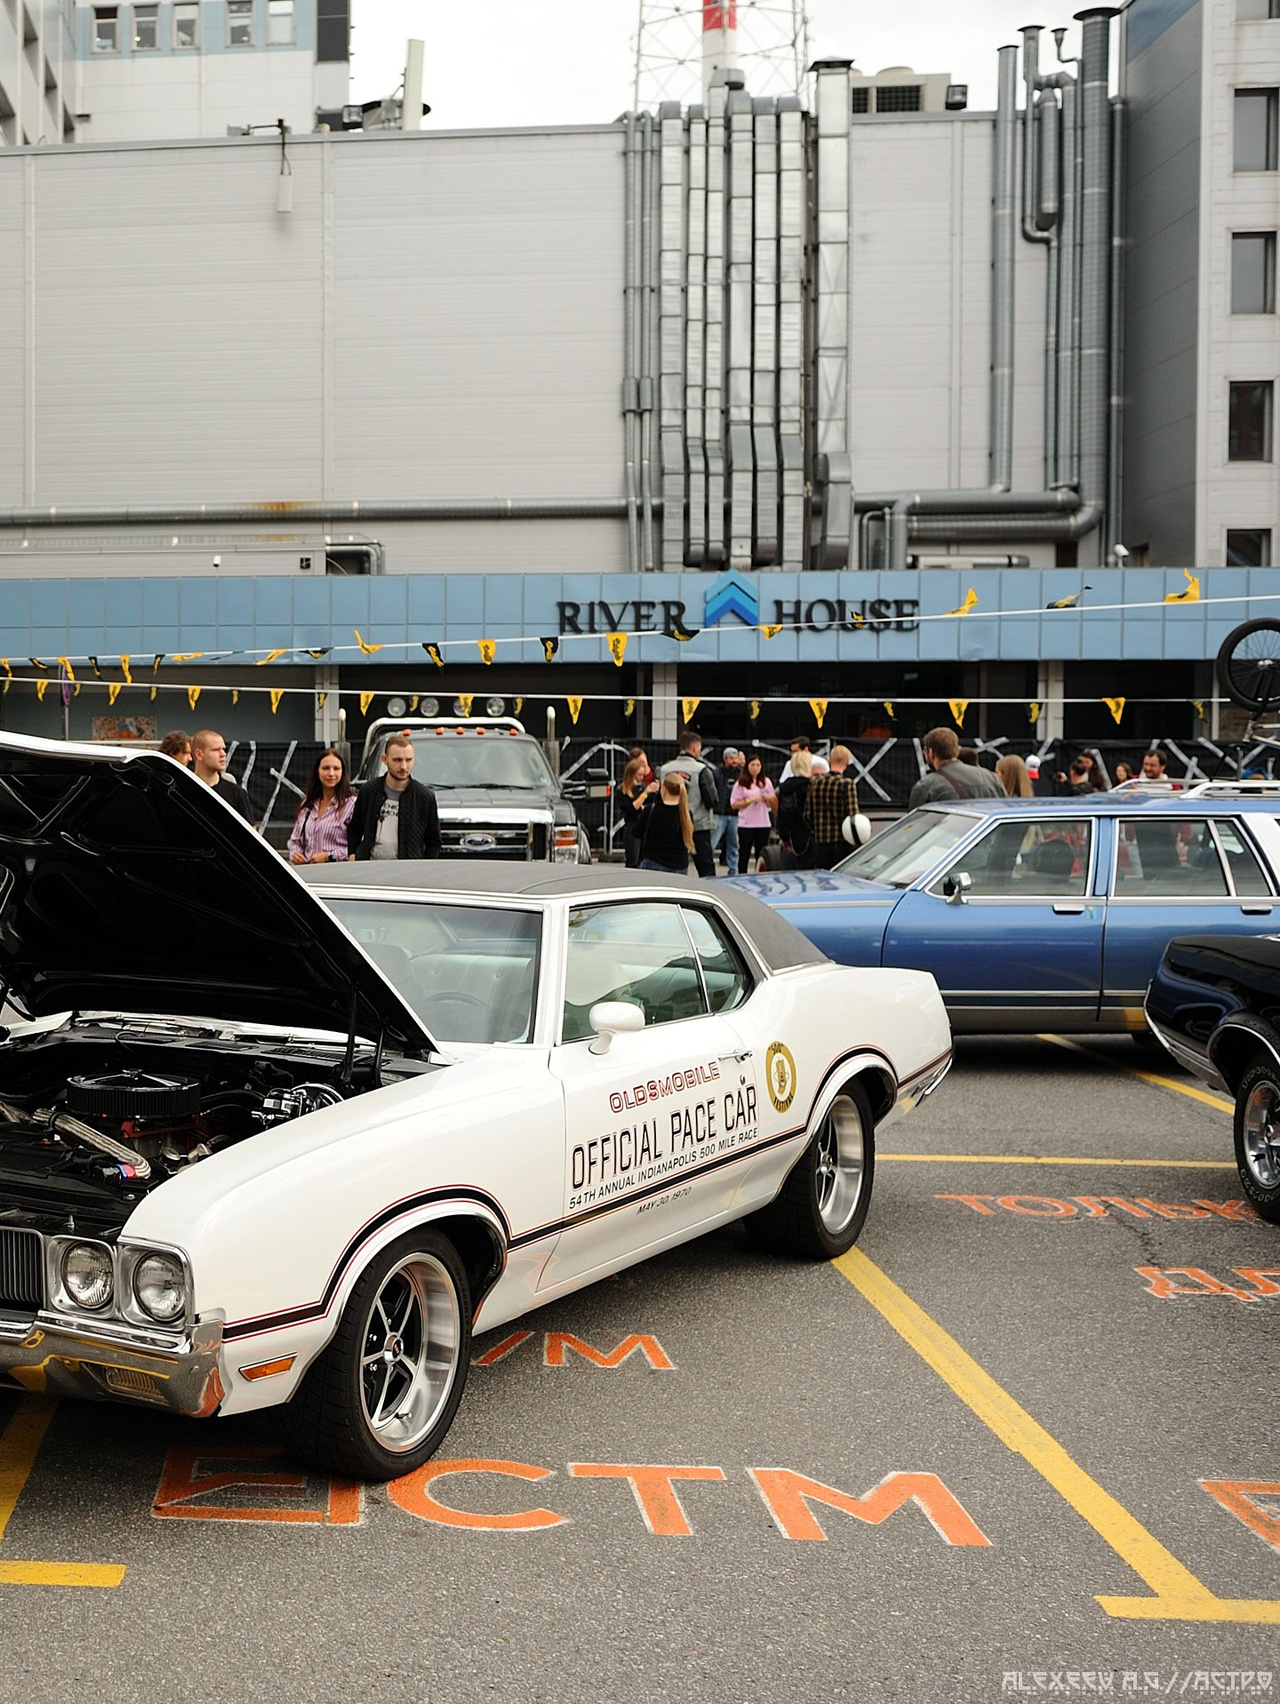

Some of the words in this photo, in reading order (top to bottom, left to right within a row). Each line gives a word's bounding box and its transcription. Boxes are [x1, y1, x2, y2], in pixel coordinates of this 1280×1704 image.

[556, 600, 687, 634] RIVER
[775, 598, 920, 632] HOUSE
[609, 1061, 721, 1113] OLDSMOBILE
[772, 1092, 794, 1112] FESTIVAL
[570, 1118, 663, 1191] OFFICIAL
[669, 1097, 718, 1154] PACE
[723, 1082, 758, 1135] CAR
[568, 1189, 597, 1209] 54TH
[598, 1176, 636, 1198] ANNUAL
[637, 1152, 697, 1183] INDIANAPOLIS
[699, 1144, 716, 1159] 500
[718, 1135, 736, 1151] MILE
[738, 1127, 758, 1145] RACE
[636, 1200, 655, 1215] MAY
[670, 1186, 692, 1203] 1970
[934, 1193, 1261, 1221] ТОЛЬК
